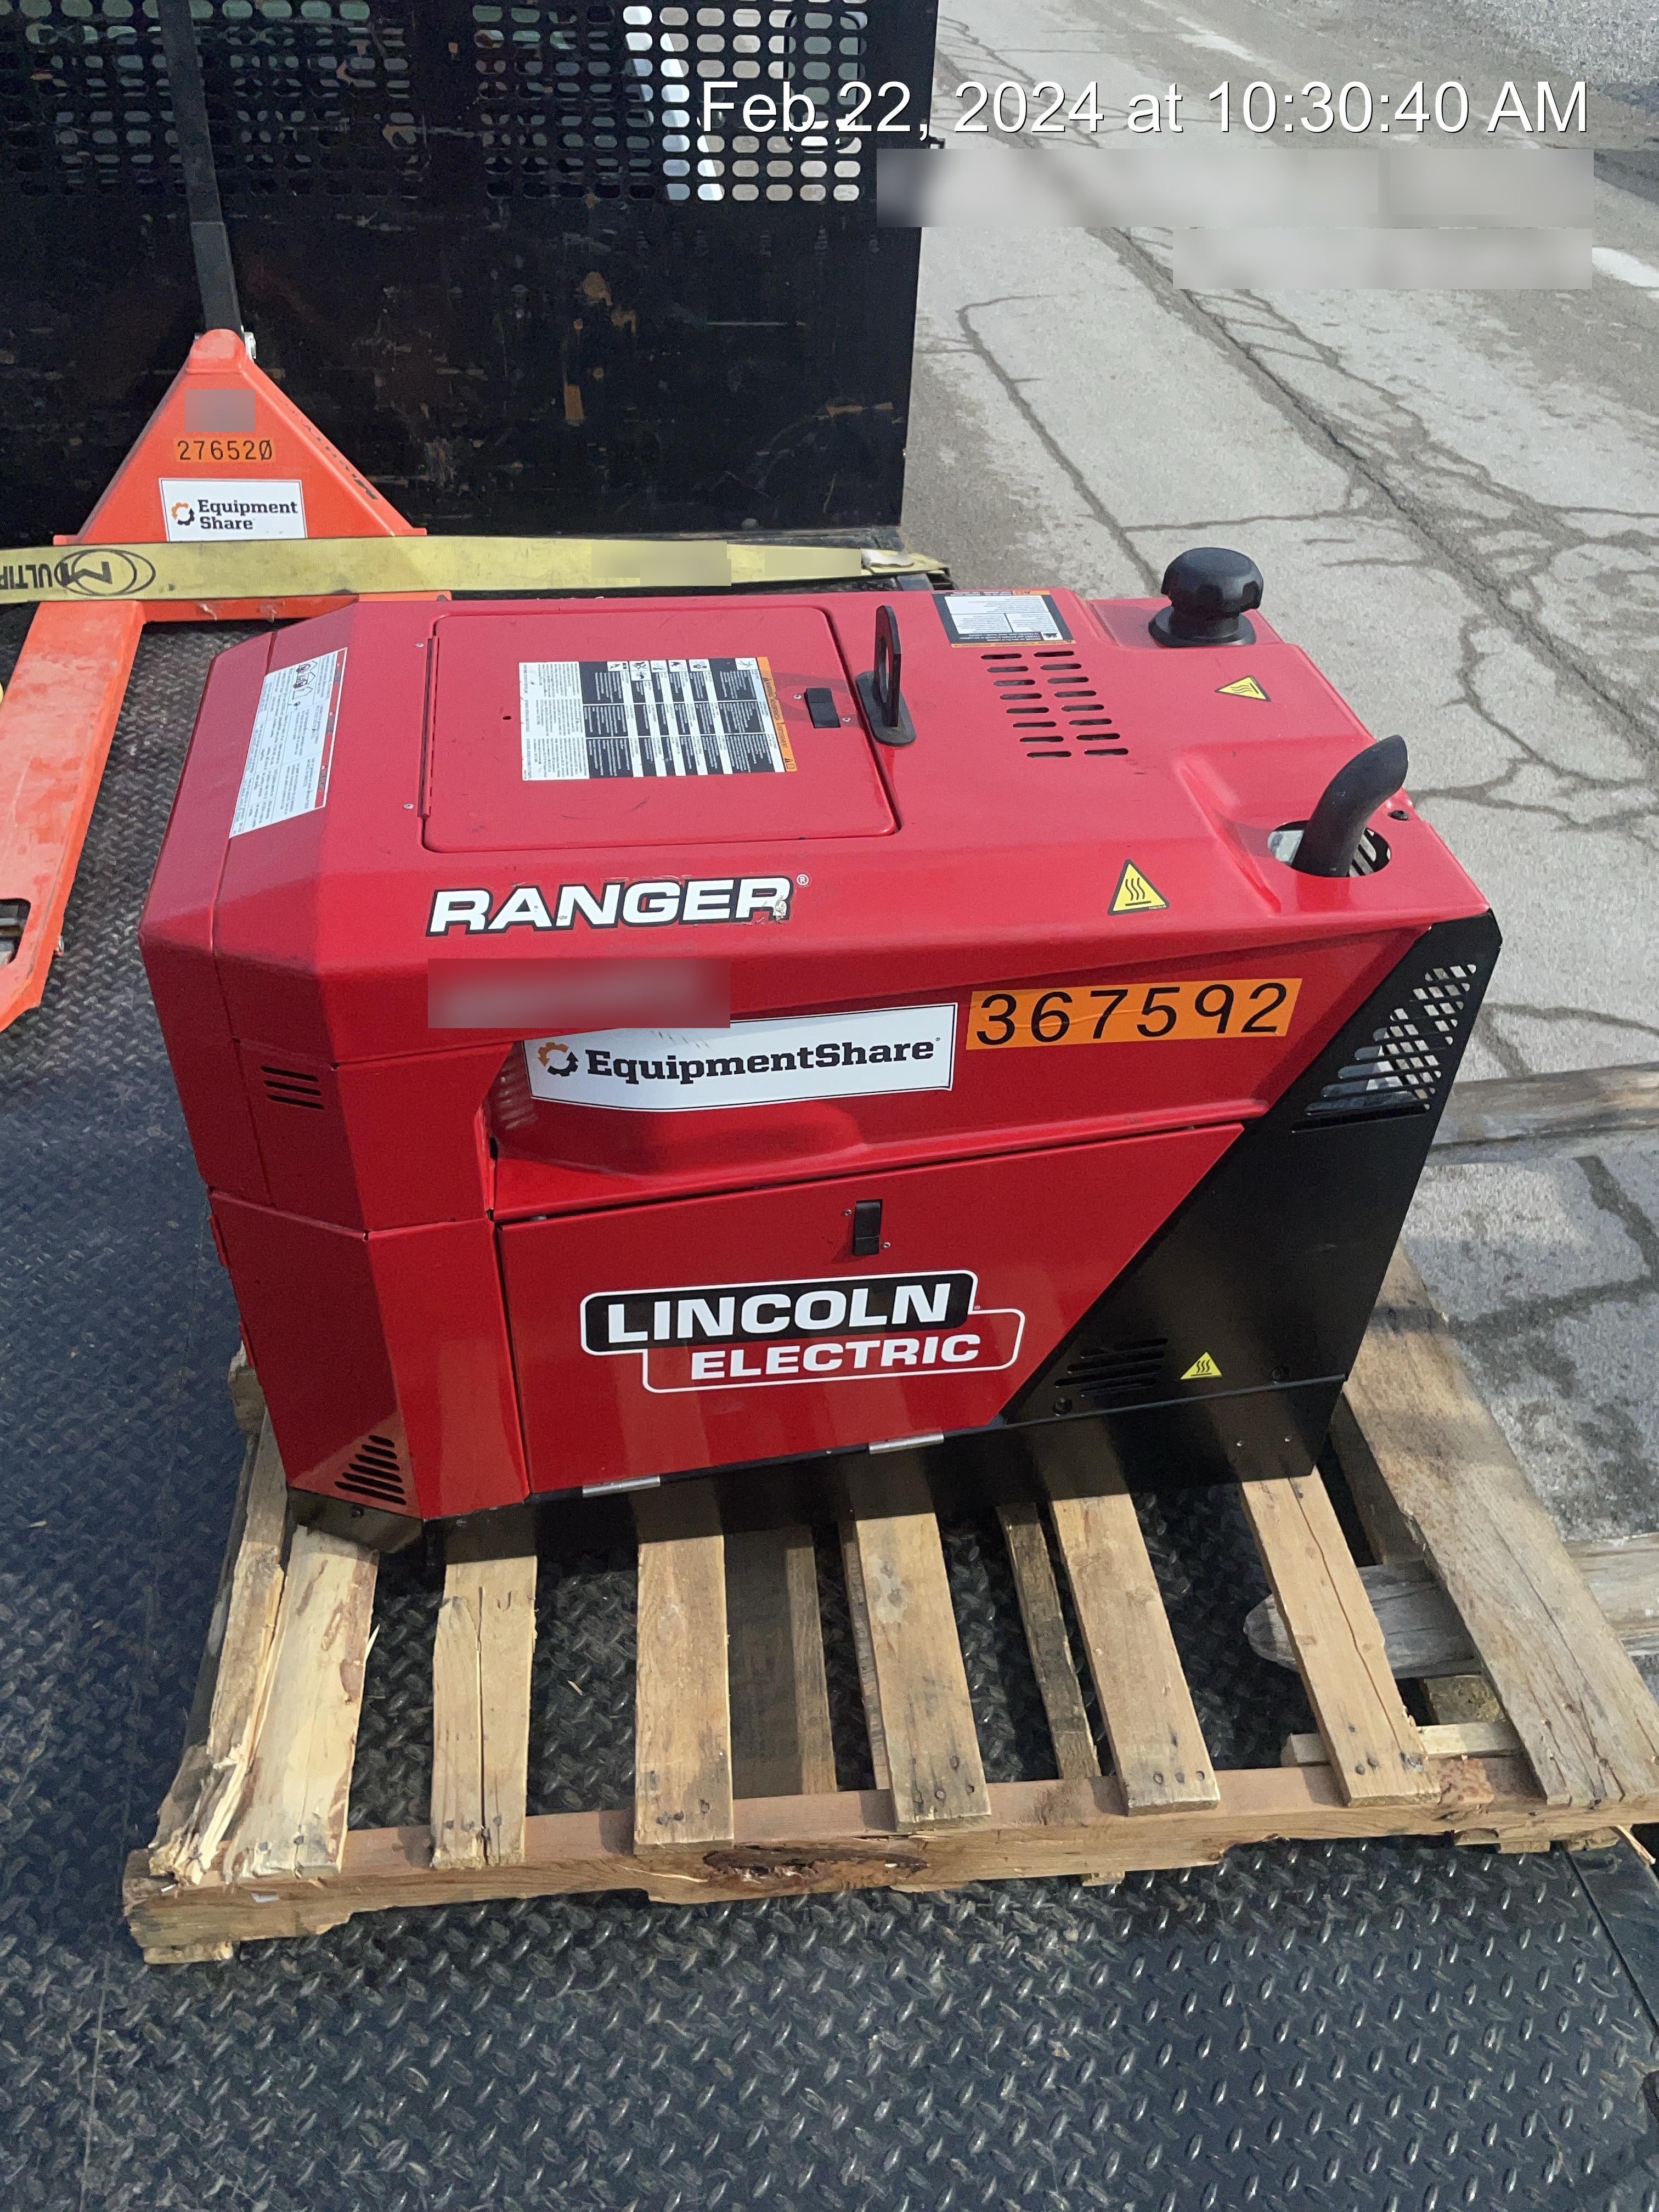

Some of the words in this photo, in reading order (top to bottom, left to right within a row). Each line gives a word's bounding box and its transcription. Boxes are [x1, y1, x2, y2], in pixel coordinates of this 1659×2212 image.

[177, 439, 273, 461] 276520
[198, 499, 298, 516] Equipment
[199, 516, 254, 530] Share
[428, 877, 792, 934] RANGER
[975, 982, 1287, 1046] 367592
[585, 1041, 935, 1085] EquipmentShare
[607, 1283, 951, 1344] LINCOLN
[691, 1334, 981, 1380] ELECTRIC
